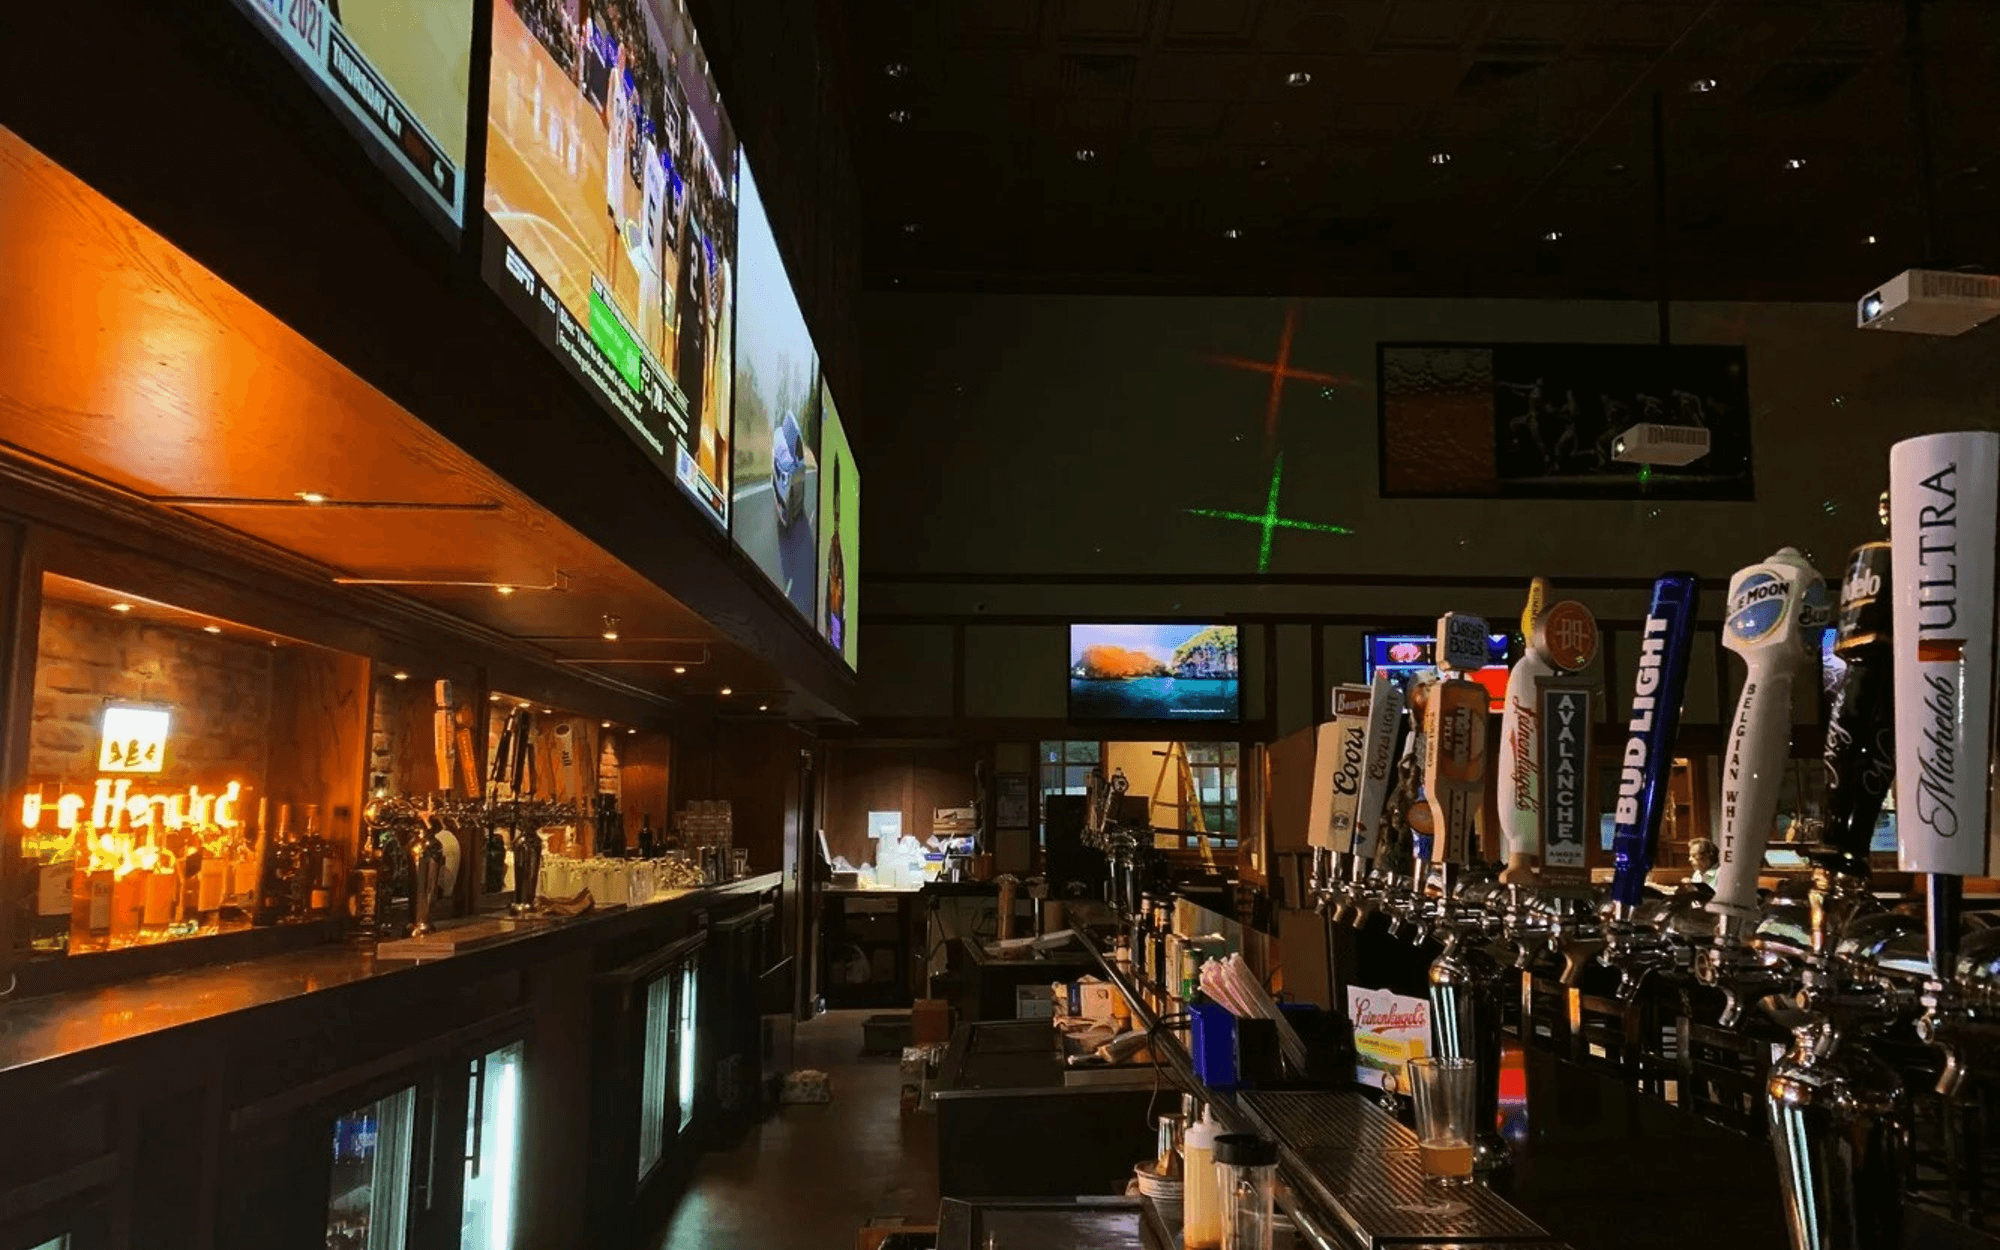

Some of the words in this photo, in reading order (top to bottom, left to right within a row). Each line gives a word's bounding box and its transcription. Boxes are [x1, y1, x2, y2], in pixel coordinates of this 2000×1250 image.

[331, 39, 386, 121] THURSDAY
[505, 245, 535, 296] ESPN
[1918, 462, 1957, 632] ULTRA
[1747, 582, 1790, 604] MOON
[1628, 613, 1668, 732] LIGHT
[1333, 726, 1364, 796] Coors
[1367, 736, 1392, 782] Coors
[1380, 695, 1400, 736] LIGHT
[1556, 694, 1576, 839] AVALANCHE
[1729, 684, 1757, 781] BELGIAN
[1916, 672, 1958, 838] Michelob
[1615, 737, 1647, 825] BUD
[1723, 790, 1739, 863] WHITE
[1354, 996, 1427, 1030] Leinenkugel's
